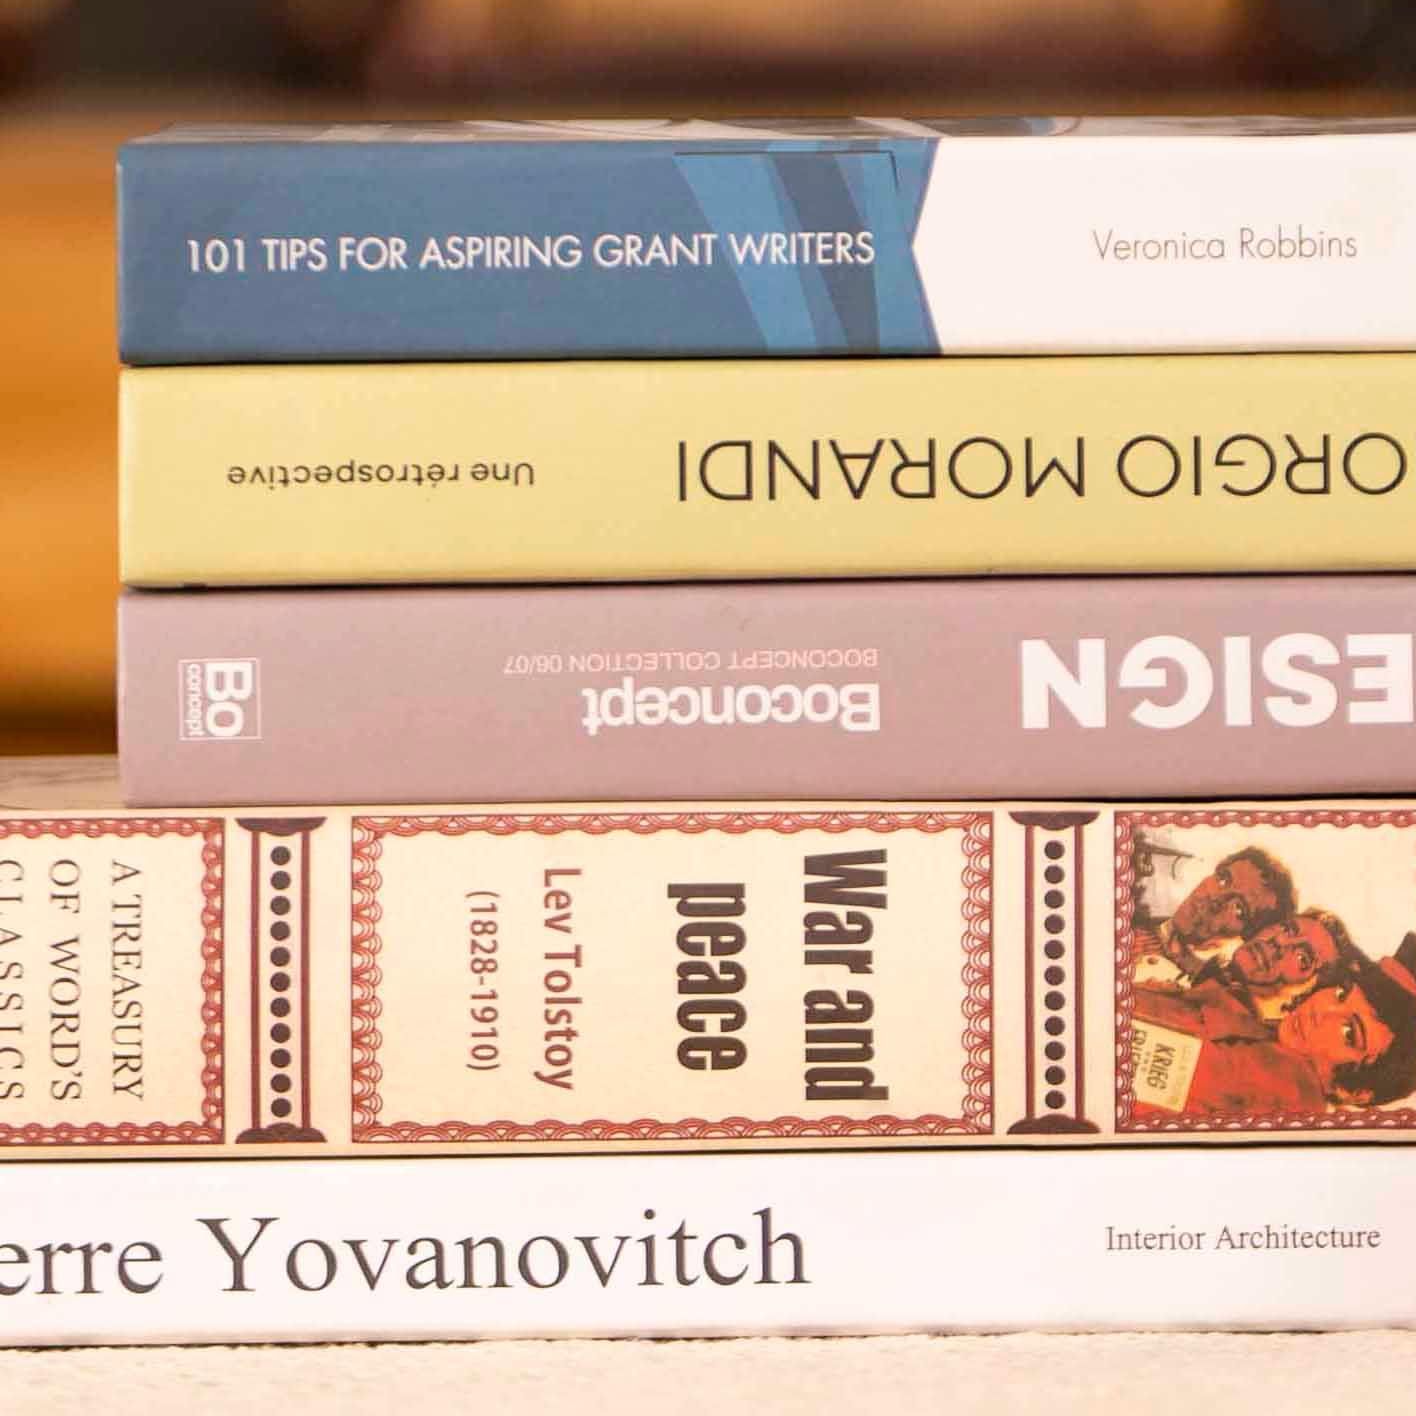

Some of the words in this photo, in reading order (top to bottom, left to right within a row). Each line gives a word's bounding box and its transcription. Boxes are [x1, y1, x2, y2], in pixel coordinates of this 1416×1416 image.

[188, 239, 246, 272] 101
[261, 238, 328, 272] TIPS
[339, 237, 408, 271] FOR
[419, 235, 583, 270] ASPIRING
[593, 234, 720, 268] GRANT
[727, 232, 875, 265] WRITERS
[1092, 229, 1225, 261] Veronica
[1239, 225, 1358, 259] Robbins
[227, 457, 460, 490] rétrospective
[470, 460, 534, 486] Une
[678, 436, 1085, 502] MORANDI
[502, 653, 563, 675] 06/07
[569, 650, 721, 673] COLLECTION
[727, 648, 879, 671] BOCONCEPT
[184, 663, 205, 737] concept
[205, 662, 253, 737] Bo
[581, 677, 881, 736] Boconcept
[49, 859, 81, 914] OF
[113, 861, 142, 883] A
[543, 867, 582, 934] Lev
[803, 848, 888, 975] War
[112, 894, 143, 1100] TREASURY
[465, 891, 500, 1072] (1828-1910)
[667, 882, 747, 1072] peace
[49, 936, 82, 1101] WORD'S
[533, 945, 583, 1091] Tolstoy
[803, 989, 889, 1101] and
[1146, 1043, 1176, 1090] KRIEG
[195, 1206, 812, 1293] Yovanovitch
[1106, 1226, 1206, 1251] Interior
[1214, 1224, 1381, 1250] Architecture
